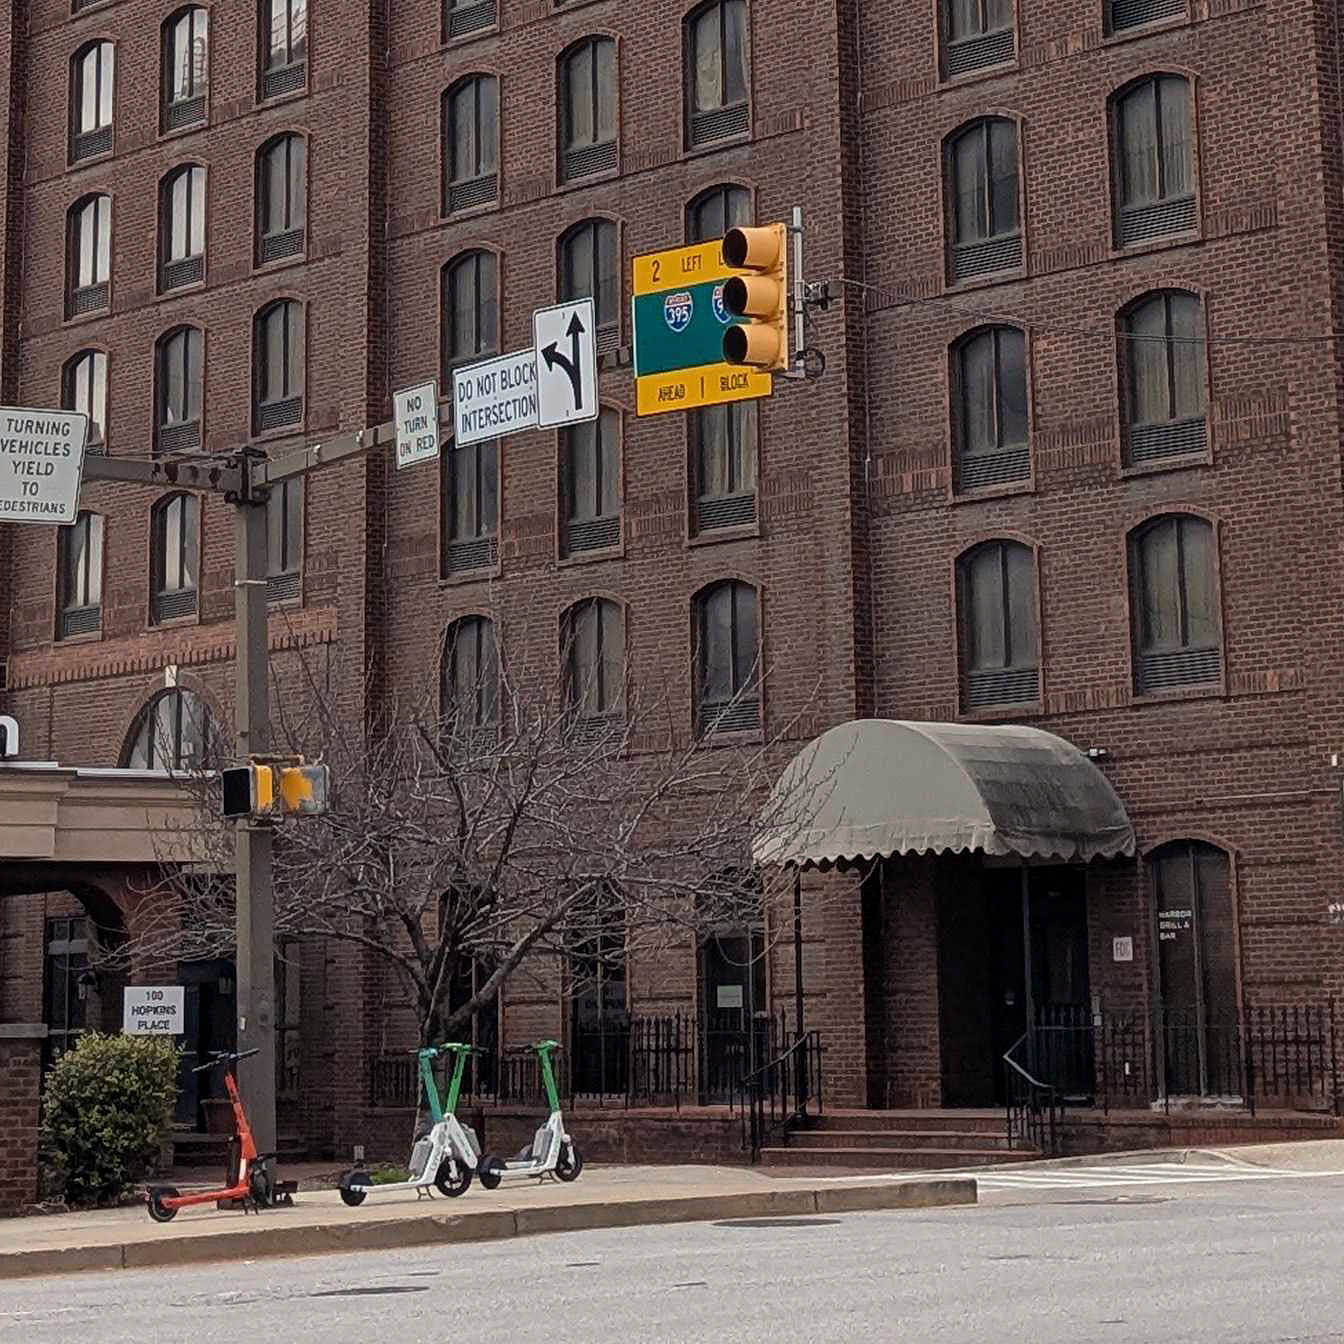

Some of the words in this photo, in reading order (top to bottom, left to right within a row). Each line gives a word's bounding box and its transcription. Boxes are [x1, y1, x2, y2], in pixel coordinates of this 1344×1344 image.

[651, 259, 661, 283] 2
[681, 255, 702, 273] LEFT
[668, 306, 689, 324] 395
[458, 379, 473, 402] DO
[477, 373, 497, 397] NOT
[500, 361, 536, 390] BLOCK
[658, 383, 685, 401] AHEAD
[720, 373, 749, 391] BLOCK
[407, 395, 422, 413] NO
[462, 393, 536, 432] INTERSECTION
[7, 418, 71, 436] TURNING
[404, 416, 428, 435] TURN
[0, 438, 71, 457] VEHICLES
[400, 441, 412, 457] ON
[416, 434, 435, 451] RED
[12, 461, 54, 476] YIELD
[21, 481, 39, 496] TO
[145, 990, 164, 1001] 100
[131, 1005, 177, 1016] HOPKINS
[137, 1020, 170, 1030] PLACE
